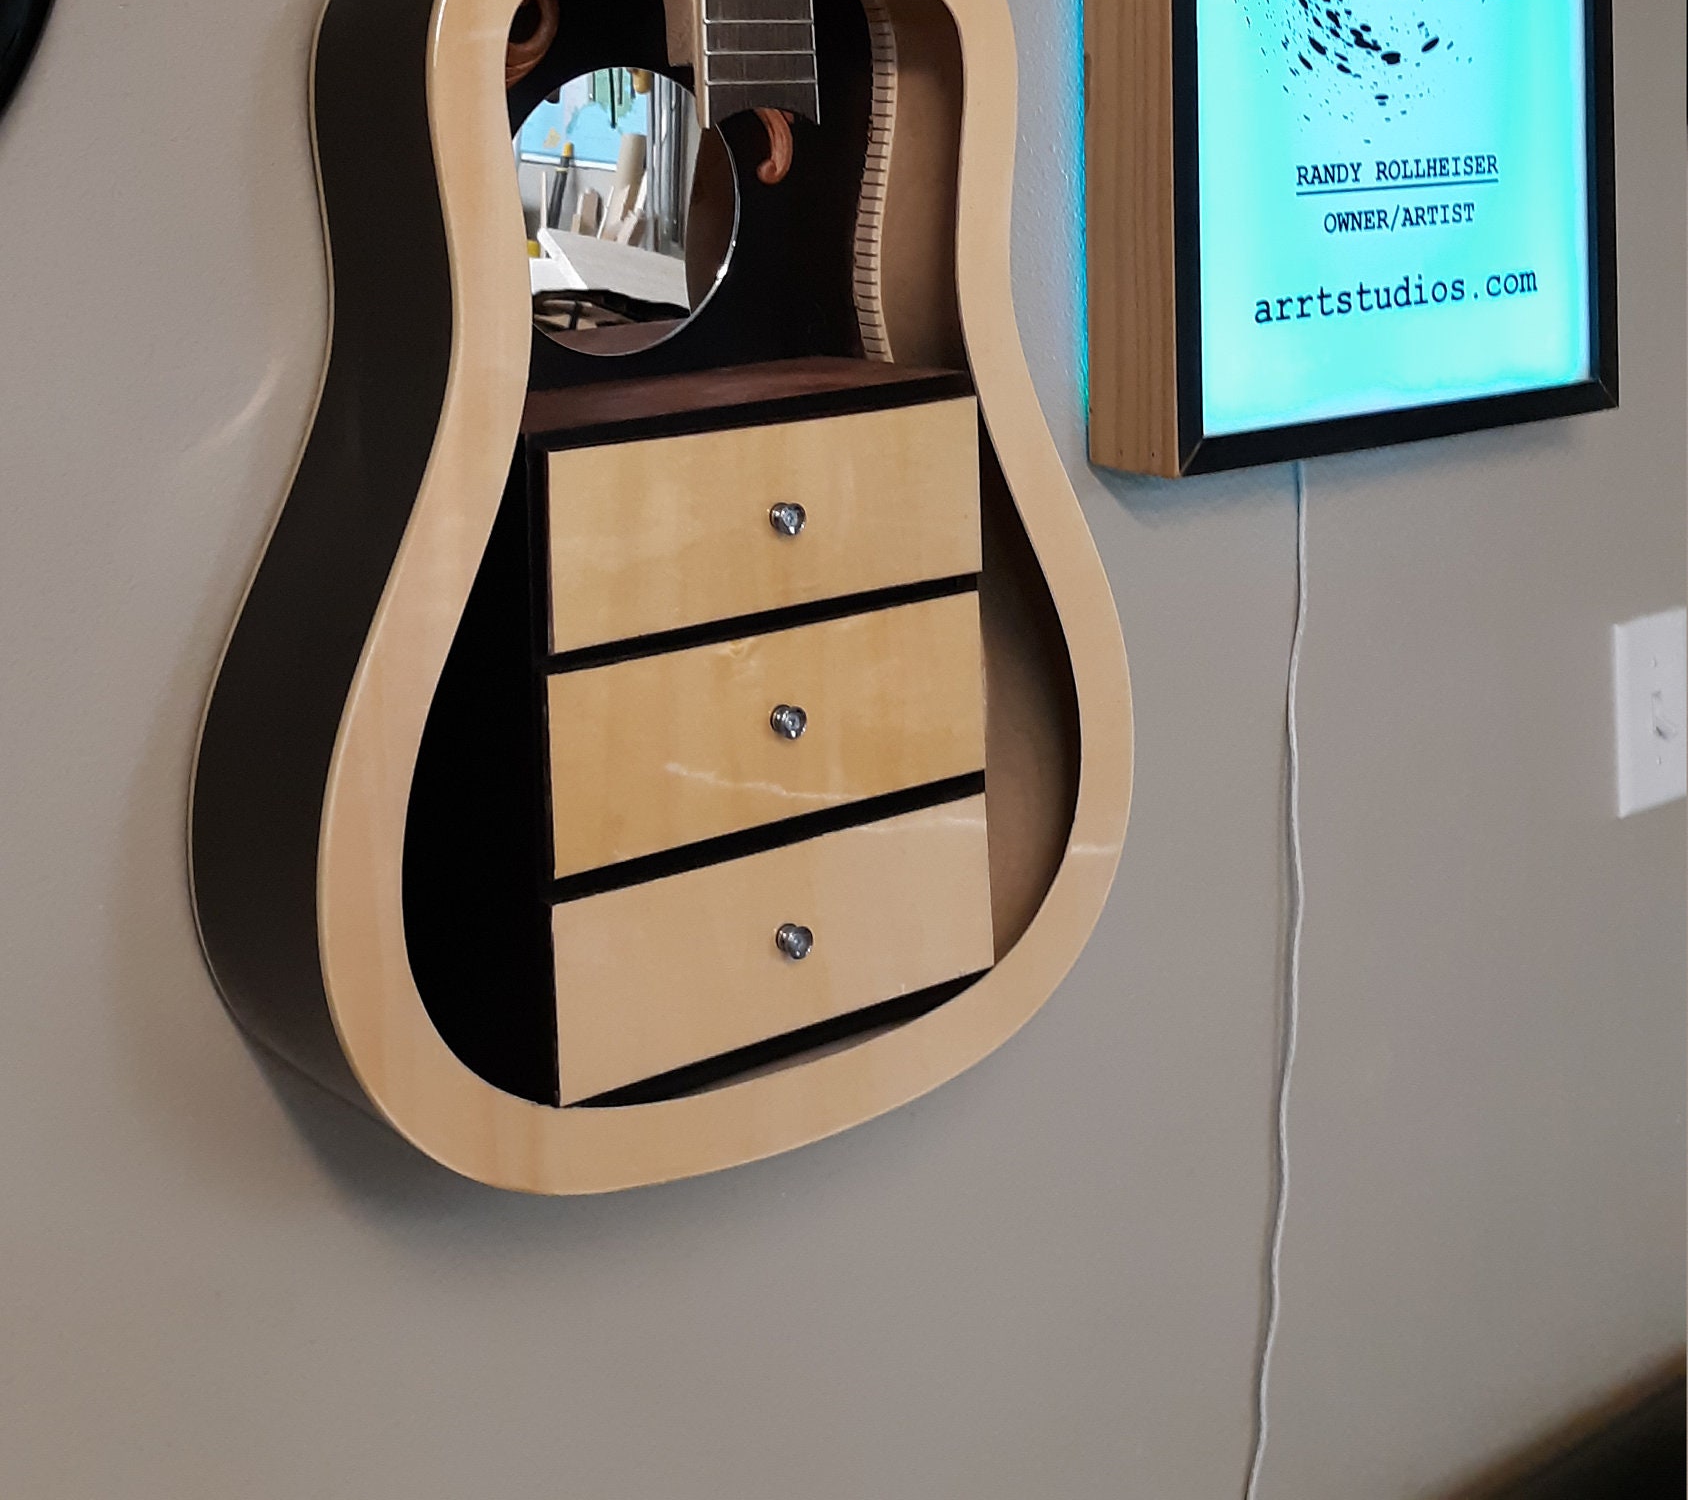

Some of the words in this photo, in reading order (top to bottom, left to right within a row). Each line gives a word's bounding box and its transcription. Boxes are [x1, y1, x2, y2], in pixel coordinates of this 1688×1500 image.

[1296, 163, 1362, 186] RANDY
[1376, 154, 1499, 181] ROLLHEISER
[1324, 202, 1475, 233] OWNER/ARTIST
[1254, 269, 1538, 323] arrtstudios.com
